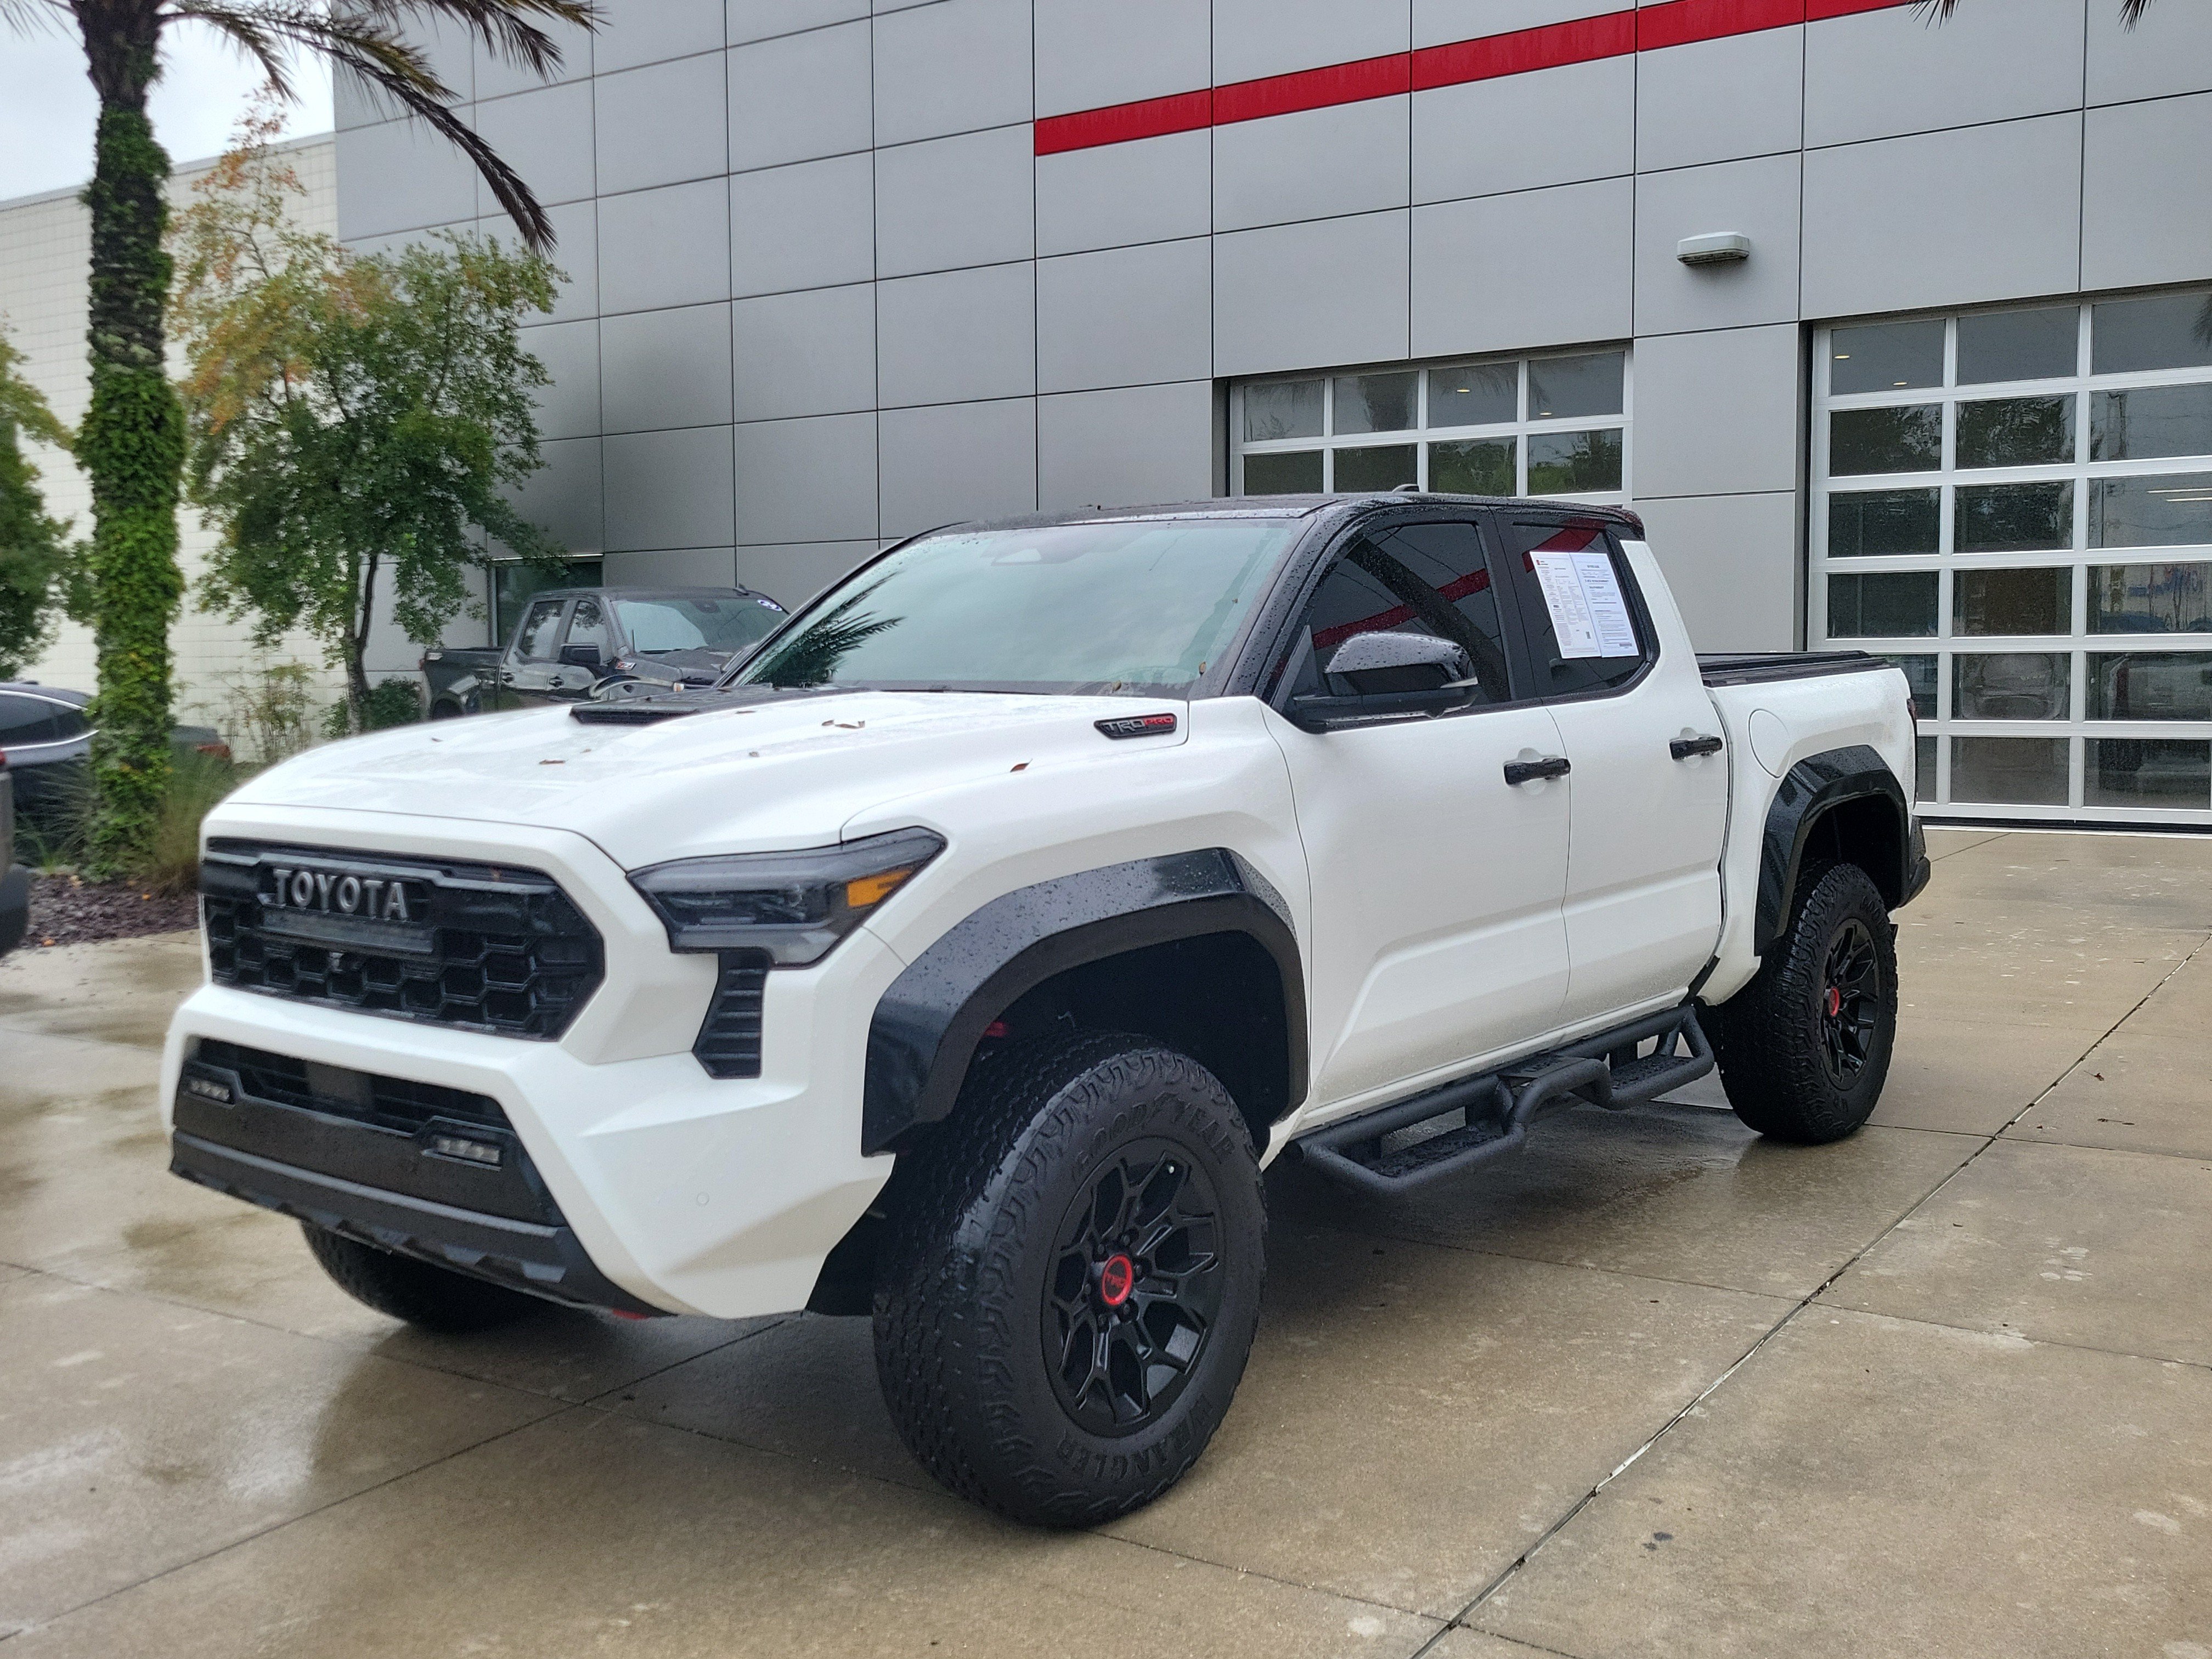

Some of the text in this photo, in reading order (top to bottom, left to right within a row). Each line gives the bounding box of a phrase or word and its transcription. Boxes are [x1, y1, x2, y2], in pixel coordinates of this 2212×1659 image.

[1103, 717, 1173, 733] TRD PRO
[273, 868, 409, 923] TOYOTA
[1057, 1393, 1214, 1480] WRANGLER
